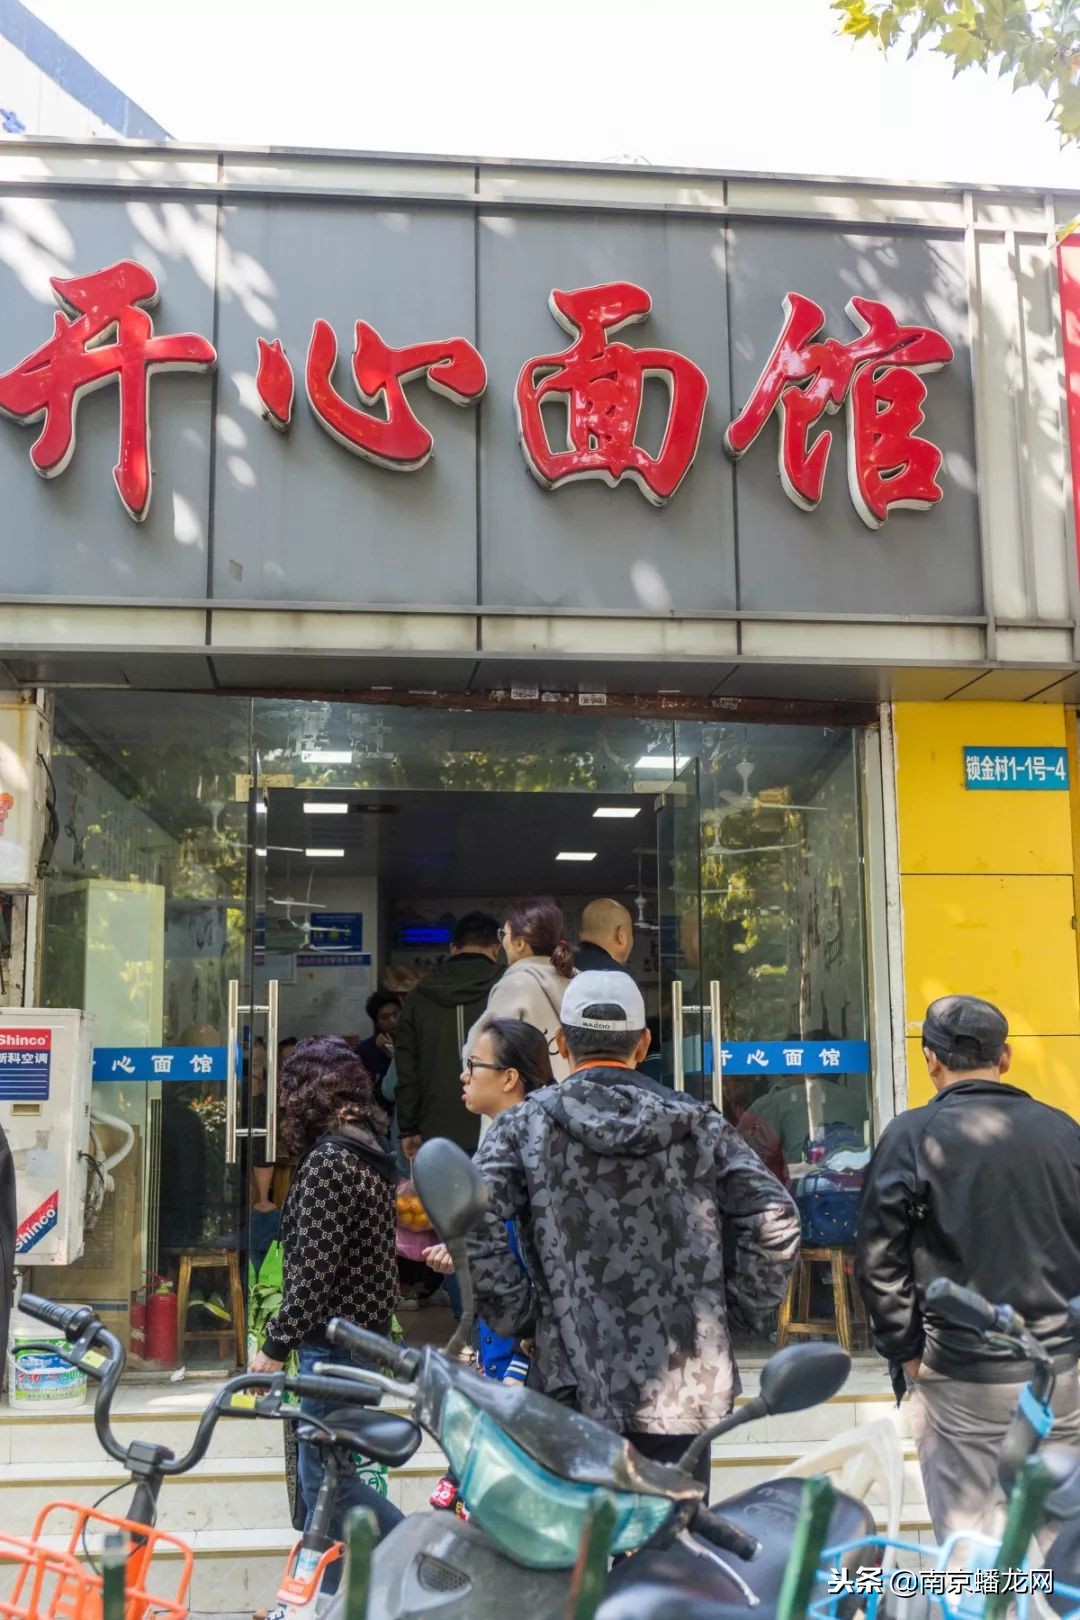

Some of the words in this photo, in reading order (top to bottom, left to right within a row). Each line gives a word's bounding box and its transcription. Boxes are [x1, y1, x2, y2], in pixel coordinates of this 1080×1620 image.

[0, 259, 953, 529] 开心面馆
[965, 755, 1066, 781] 锁金村1-1号-4
[92, 1054, 213, 1073] 心面馆
